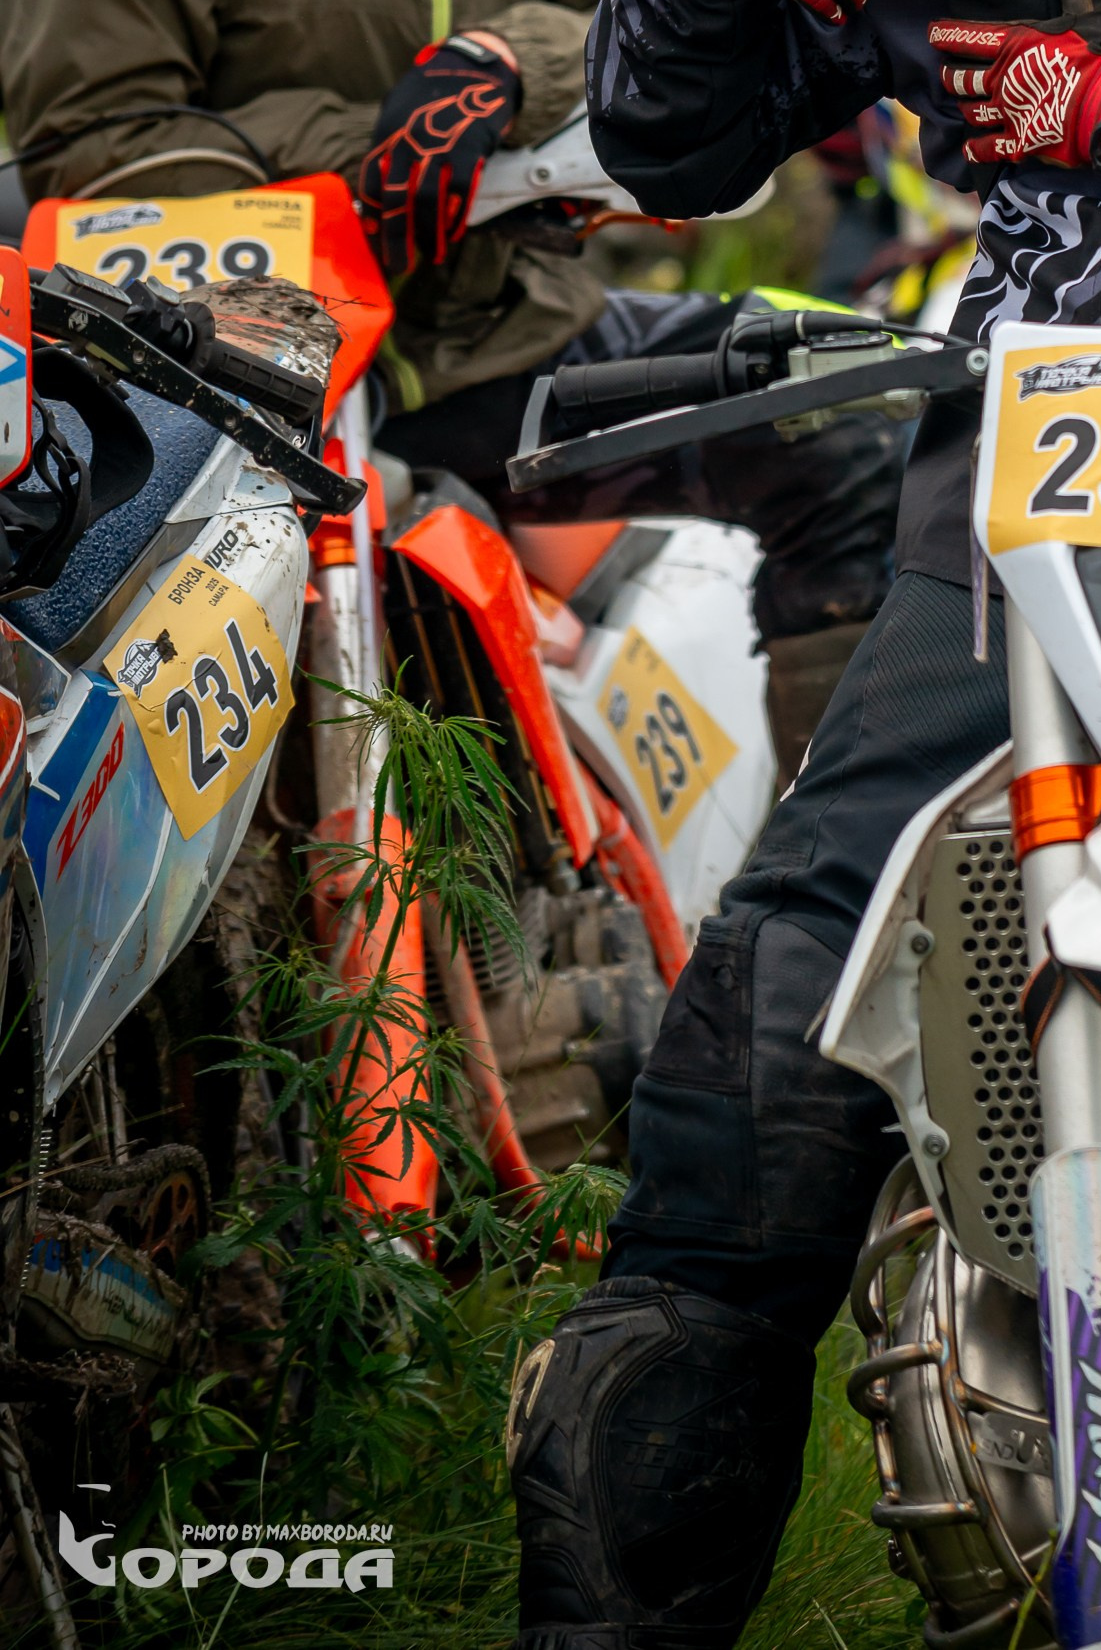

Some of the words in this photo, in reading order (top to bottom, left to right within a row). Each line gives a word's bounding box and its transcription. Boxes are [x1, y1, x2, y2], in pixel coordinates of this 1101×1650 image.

[929, 26, 1005, 47] FASTHOUSE
[168, 566, 206, 606] БРОНЗА
[205, 577, 220, 592] 2025
[208, 585, 230, 607] САМАРА
[164, 620, 279, 793] 234
[635, 692, 701, 815] 239
